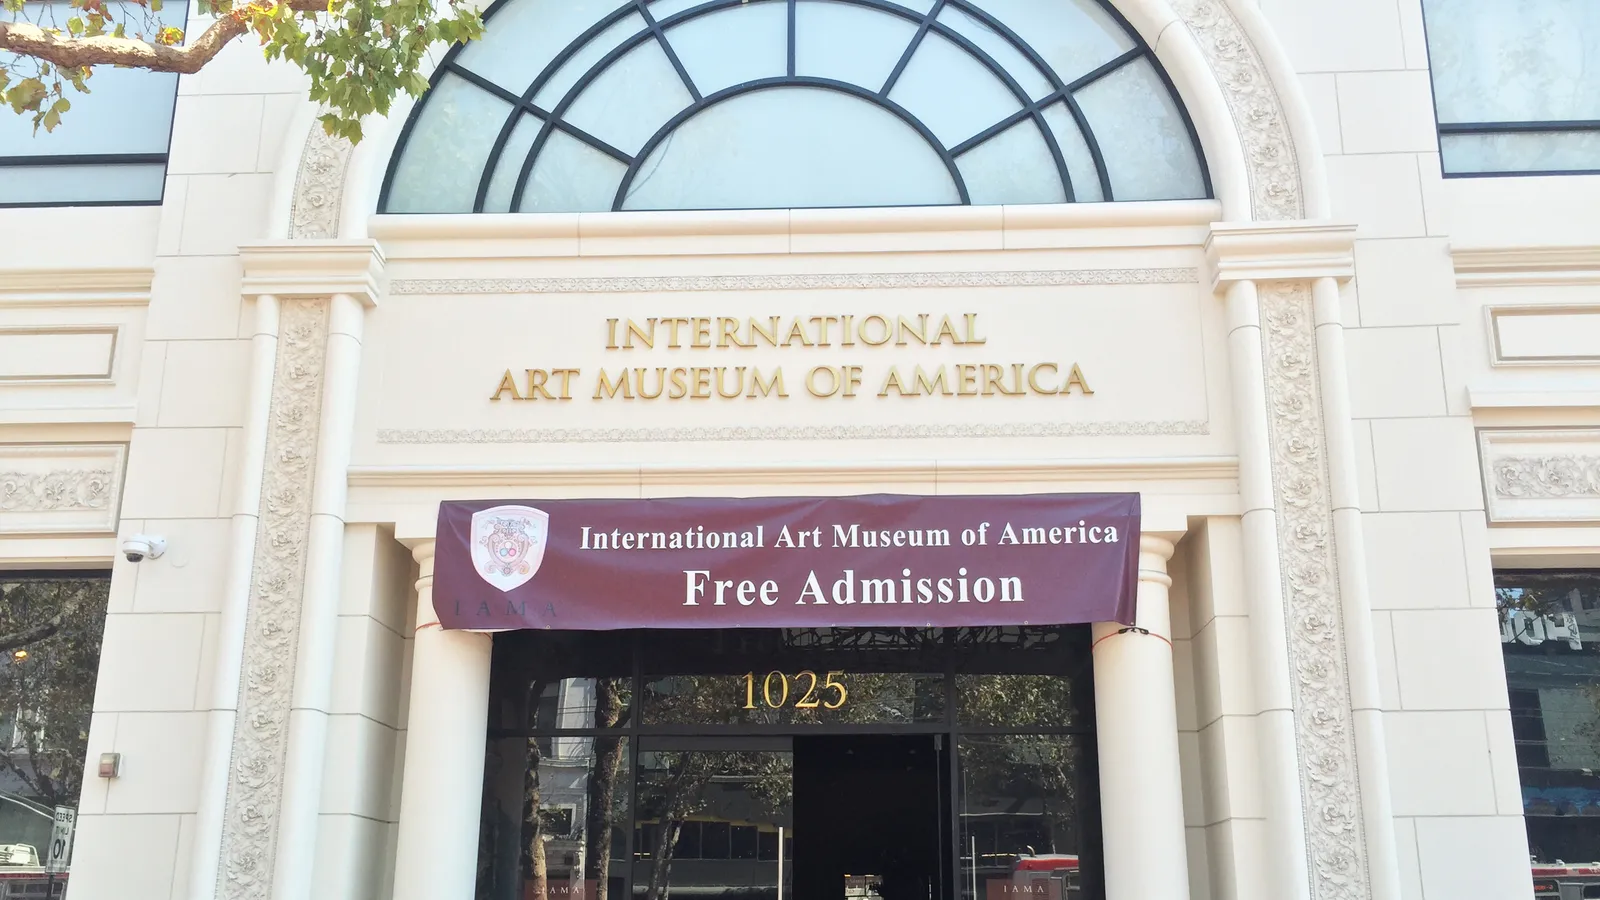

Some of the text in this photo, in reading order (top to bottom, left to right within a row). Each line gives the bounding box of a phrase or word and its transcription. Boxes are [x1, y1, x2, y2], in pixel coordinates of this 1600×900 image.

[605, 313, 987, 349] INTERNATIONAL
[489, 362, 1095, 401] ART MUSEUM OF AMERICA
[579, 519, 1120, 550] International Art Museum of America
[682, 567, 1025, 607] Free Admission
[741, 668, 847, 709] 1025
